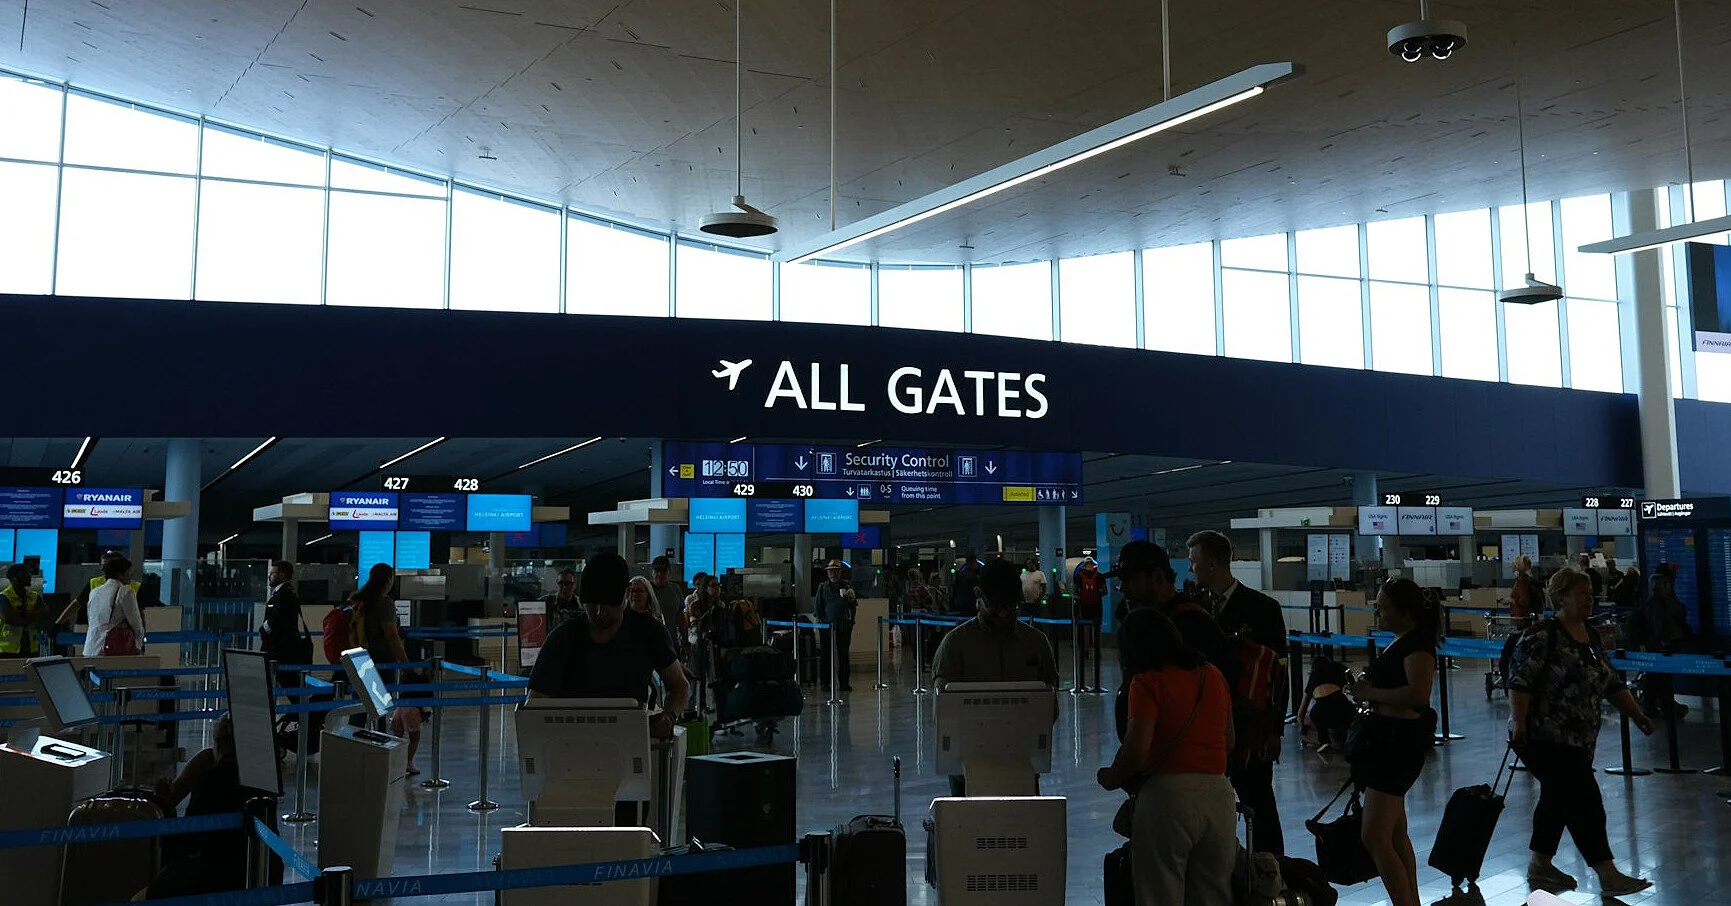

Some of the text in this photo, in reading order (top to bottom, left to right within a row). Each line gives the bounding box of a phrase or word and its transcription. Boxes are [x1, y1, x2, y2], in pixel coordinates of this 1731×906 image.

[1702, 339, 1731, 347] FINNAIR
[765, 361, 1048, 419] ALL GATES
[846, 453, 949, 471] Security Control
[703, 460, 749, 477] 12:50
[842, 469, 953, 478] Turvatarkastus Säkerhetskontroll
[52, 470, 82, 484] 426
[384, 477, 410, 490] 427
[454, 478, 479, 491] 428
[880, 484, 892, 494] 0-5
[734, 484, 755, 496] 429
[793, 485, 815, 497] 430
[901, 485, 925, 494] Queuing
[84, 494, 132, 502] RYANAIR
[1386, 494, 1401, 505] 230
[1426, 495, 1440, 505] 229
[1585, 497, 1600, 508] 228
[1620, 498, 1634, 508] 227
[1656, 503, 1695, 512] Departures
[40, 824, 121, 844] FINAVIA
[594, 860, 673, 880] FINAVIA
